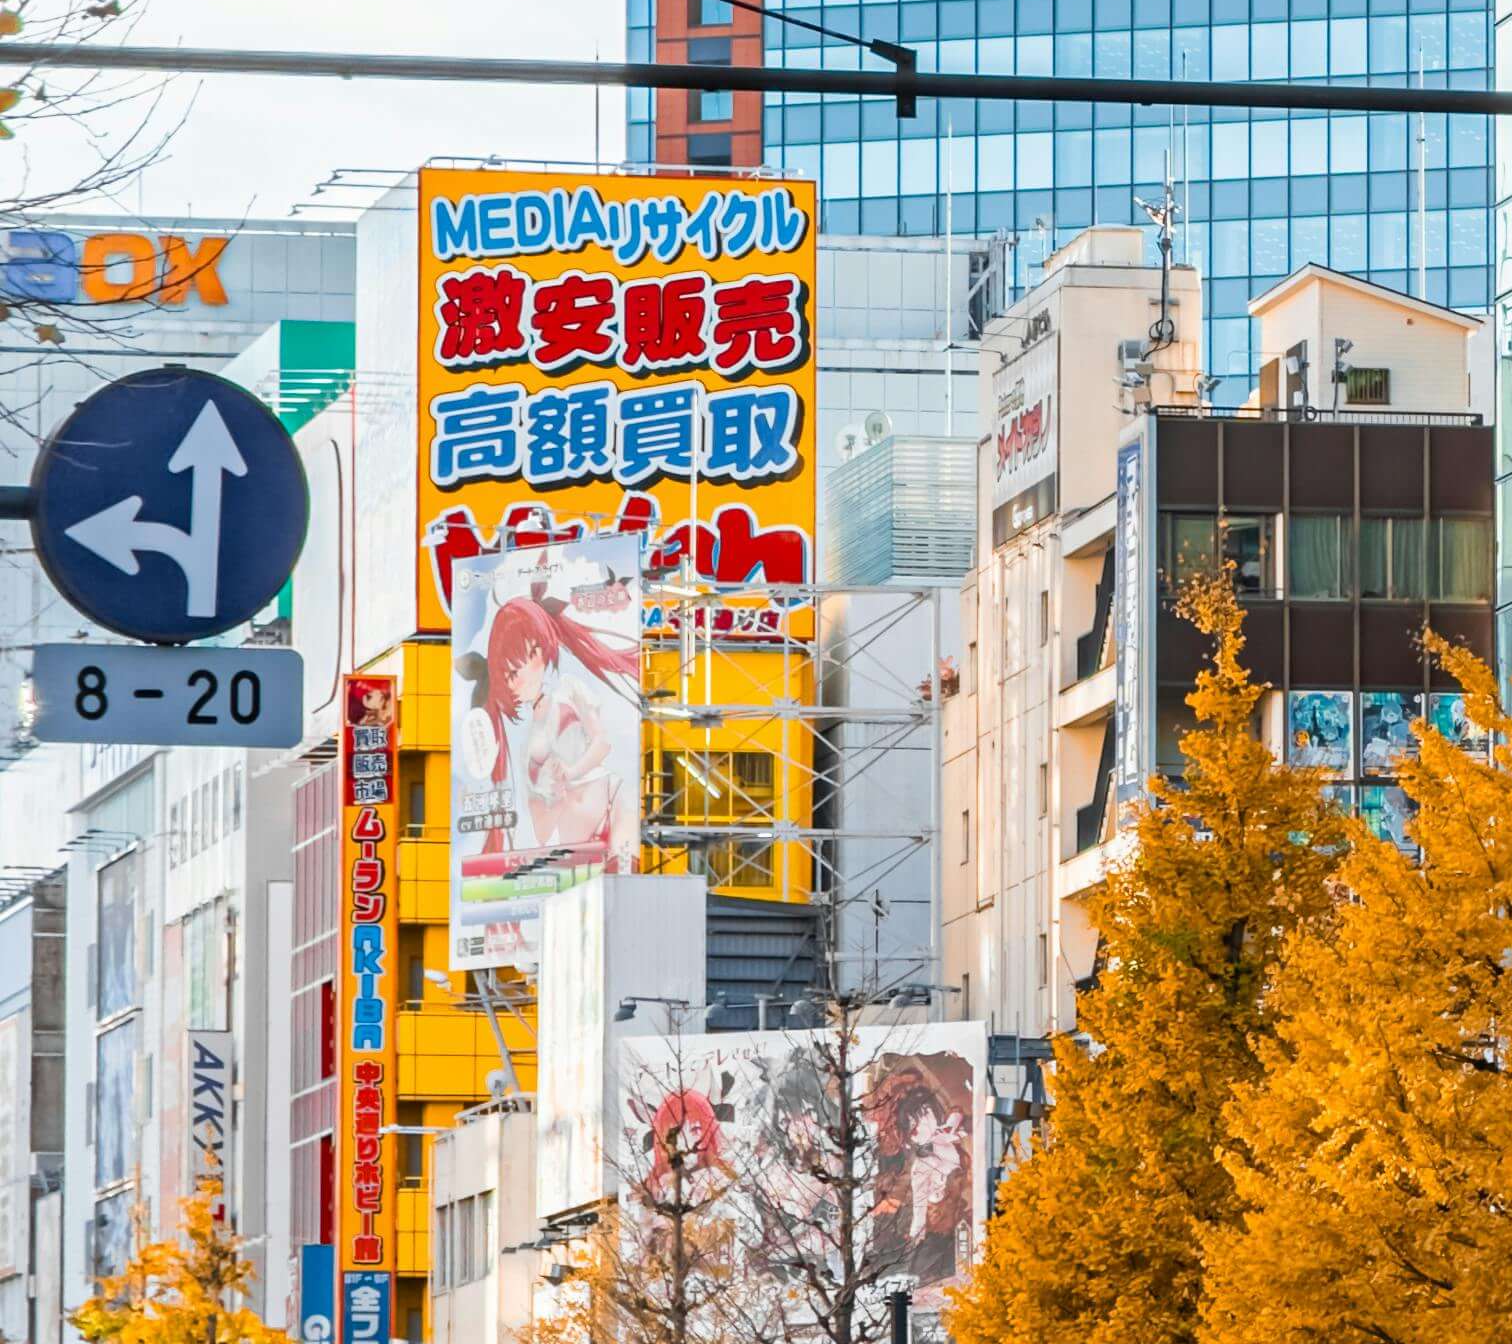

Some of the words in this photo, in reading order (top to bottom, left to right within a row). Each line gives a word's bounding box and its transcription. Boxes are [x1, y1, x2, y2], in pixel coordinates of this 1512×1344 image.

[440, 268, 797, 370] 激安販売
[436, 387, 793, 478] 高額買取
[352, 1061, 384, 1264] 中央通りホビー館
